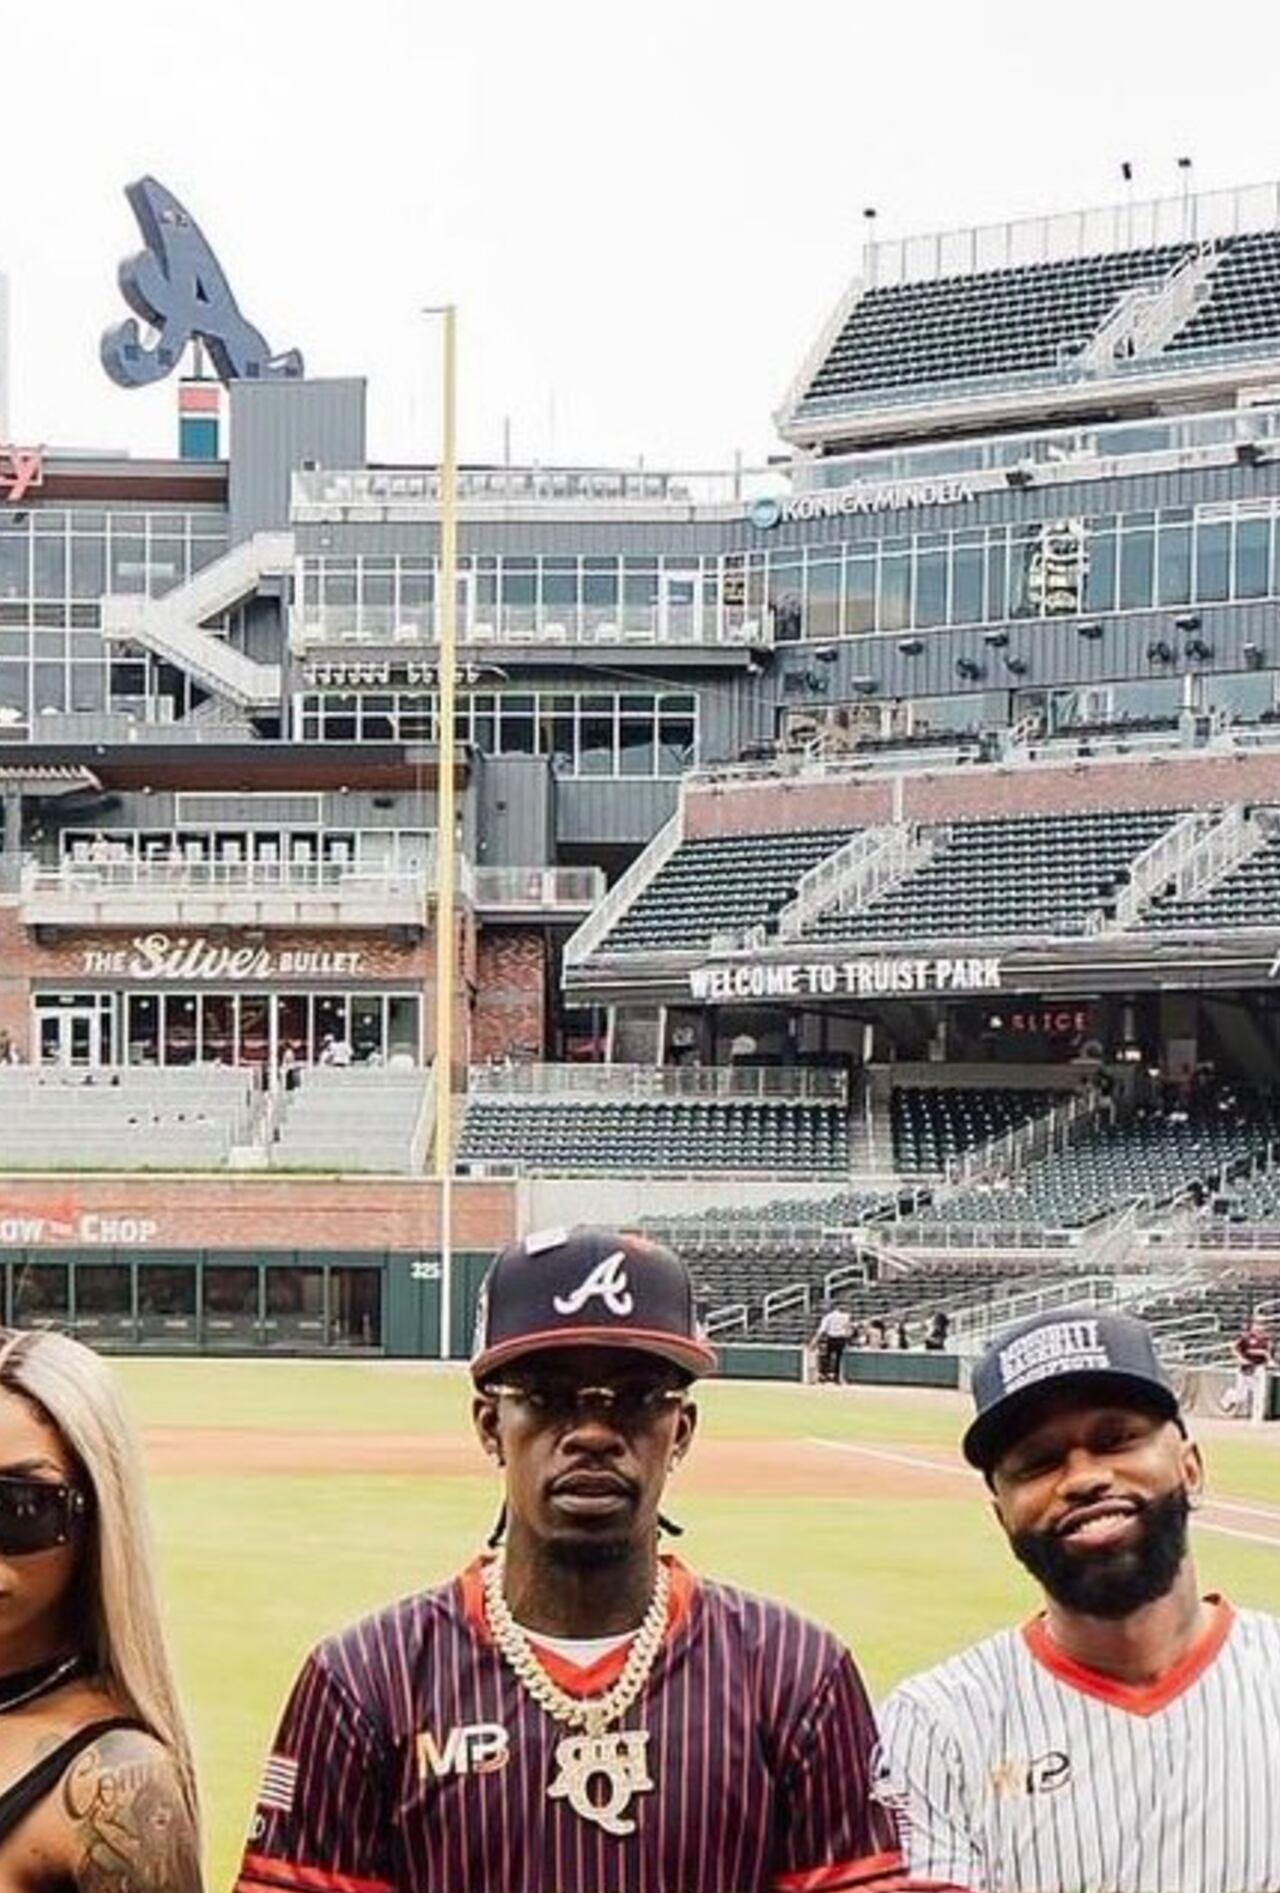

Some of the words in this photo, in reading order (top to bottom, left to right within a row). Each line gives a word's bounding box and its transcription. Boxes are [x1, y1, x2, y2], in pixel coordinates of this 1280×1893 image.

[82, 951, 127, 974] THE
[130, 931, 276, 979] Silver
[689, 964, 800, 999] WELCOME
[806, 963, 837, 993] TO
[842, 959, 929, 993] TRUIST
[935, 957, 1002, 988] PARK
[79, 1213, 158, 1243] CHOP
[553, 1251, 632, 1315] A
